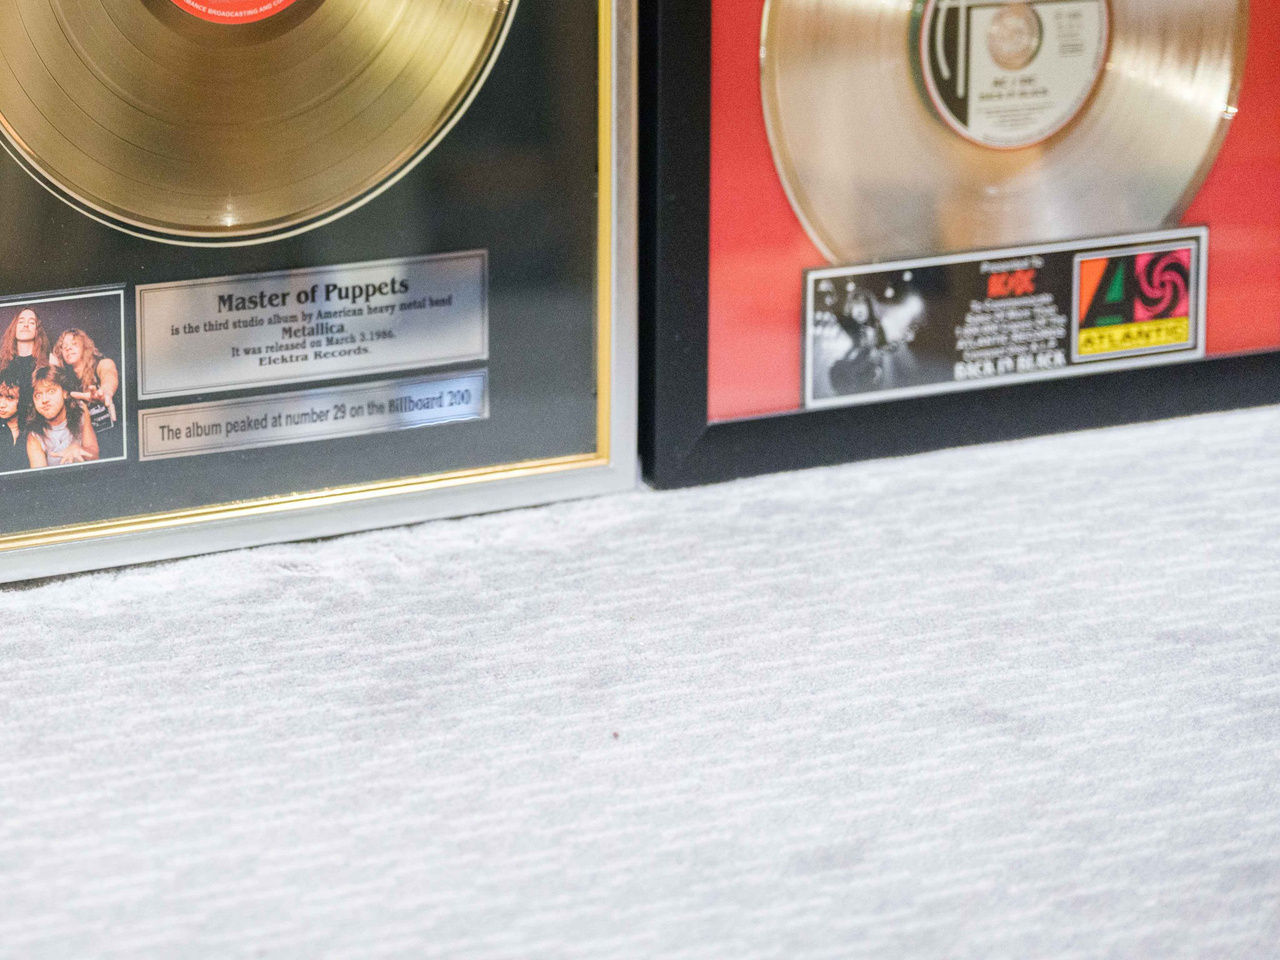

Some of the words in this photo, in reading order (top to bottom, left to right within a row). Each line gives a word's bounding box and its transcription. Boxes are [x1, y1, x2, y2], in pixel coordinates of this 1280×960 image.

[218, 290, 290, 313] Master
[296, 284, 319, 304] of
[324, 277, 410, 303] Puppets
[171, 325, 180, 336] is
[183, 324, 200, 334] the
[204, 319, 229, 332] third
[232, 317, 264, 330] studio
[267, 312, 298, 326] album
[301, 311, 313, 324] by
[315, 306, 364, 320] American
[367, 303, 396, 316] heavy
[281, 321, 345, 340] Metallica
[231, 346, 241, 358] It
[243, 344, 263, 356] was
[265, 341, 307, 354] released
[258, 352, 309, 366] Elektra
[159, 424, 181, 442] The
[185, 421, 222, 440] album
[225, 413, 268, 438] peaked
[271, 413, 283, 428] at
[285, 406, 329, 427] number
[349, 404, 365, 419] on
[366, 400, 386, 416] the
[388, 391, 444, 415] Billboard
